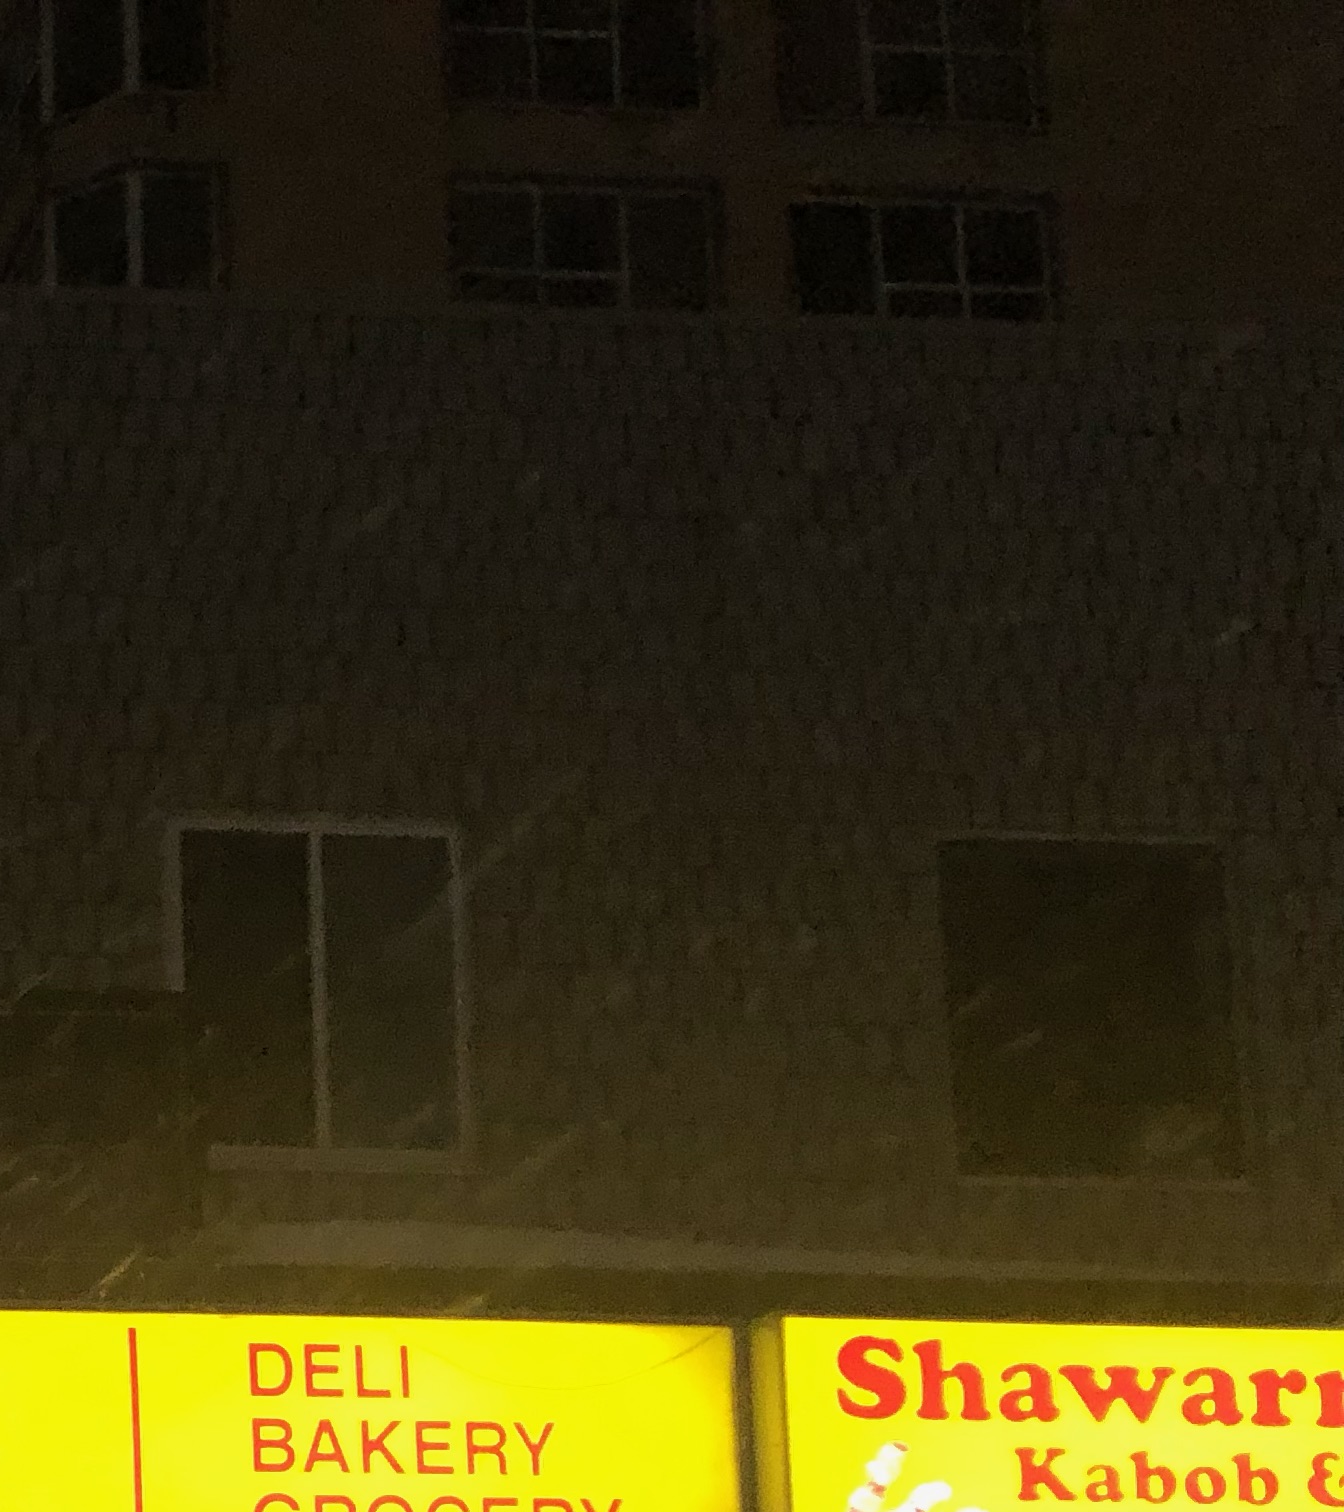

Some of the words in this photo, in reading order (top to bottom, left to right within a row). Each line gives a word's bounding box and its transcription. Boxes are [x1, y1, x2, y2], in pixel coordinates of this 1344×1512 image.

[248, 1343, 410, 1398] DELI
[252, 1418, 555, 1476] BAKERY
[1015, 1447, 1279, 1505] Kabob
